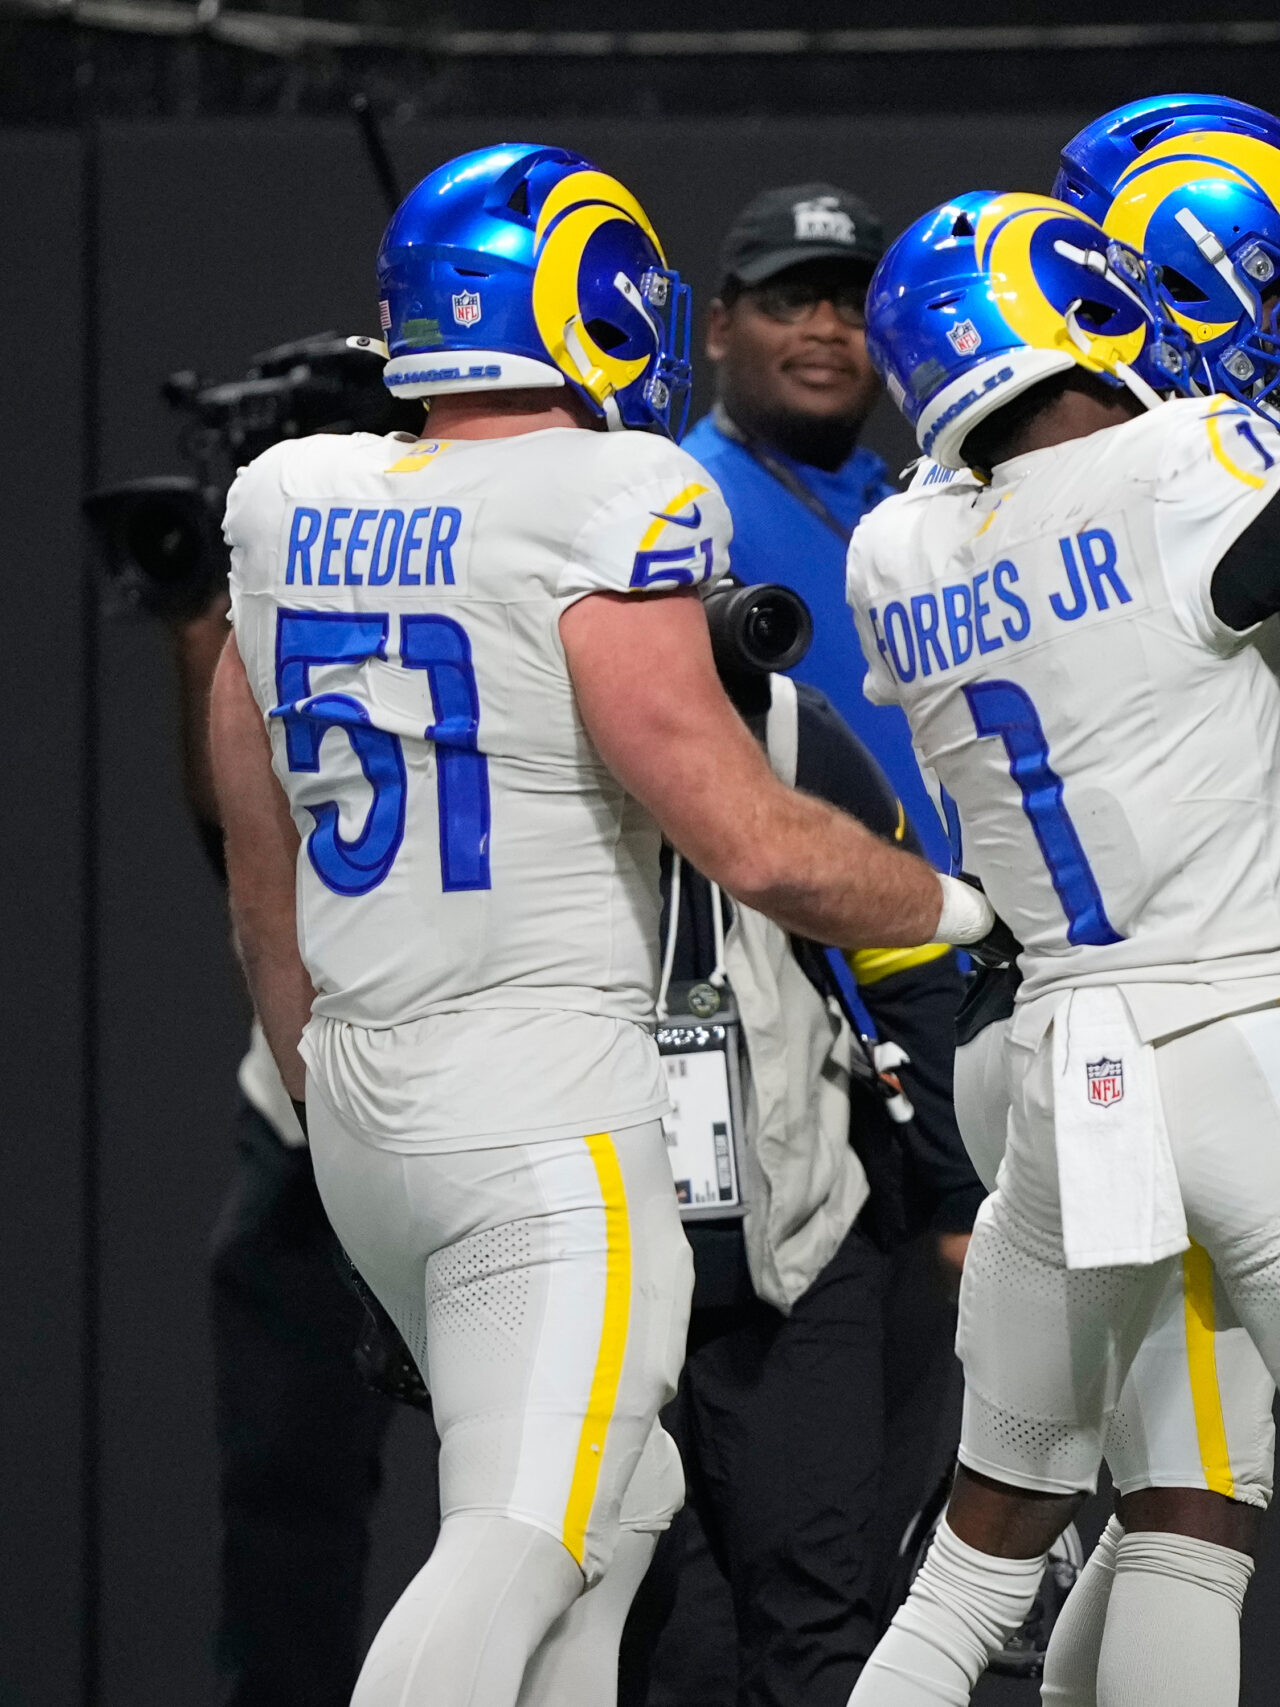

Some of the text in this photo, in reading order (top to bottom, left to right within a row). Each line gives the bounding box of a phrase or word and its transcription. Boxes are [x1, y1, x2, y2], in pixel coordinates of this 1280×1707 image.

[458, 306, 478, 320] NFL
[956, 331, 979, 351] NFL
[285, 507, 462, 586] REEDER
[629, 537, 714, 588] 51
[1049, 528, 1133, 621] JR
[269, 607, 492, 897] 51
[962, 679, 1126, 947] 1
[1091, 1078, 1121, 1102] NFL
